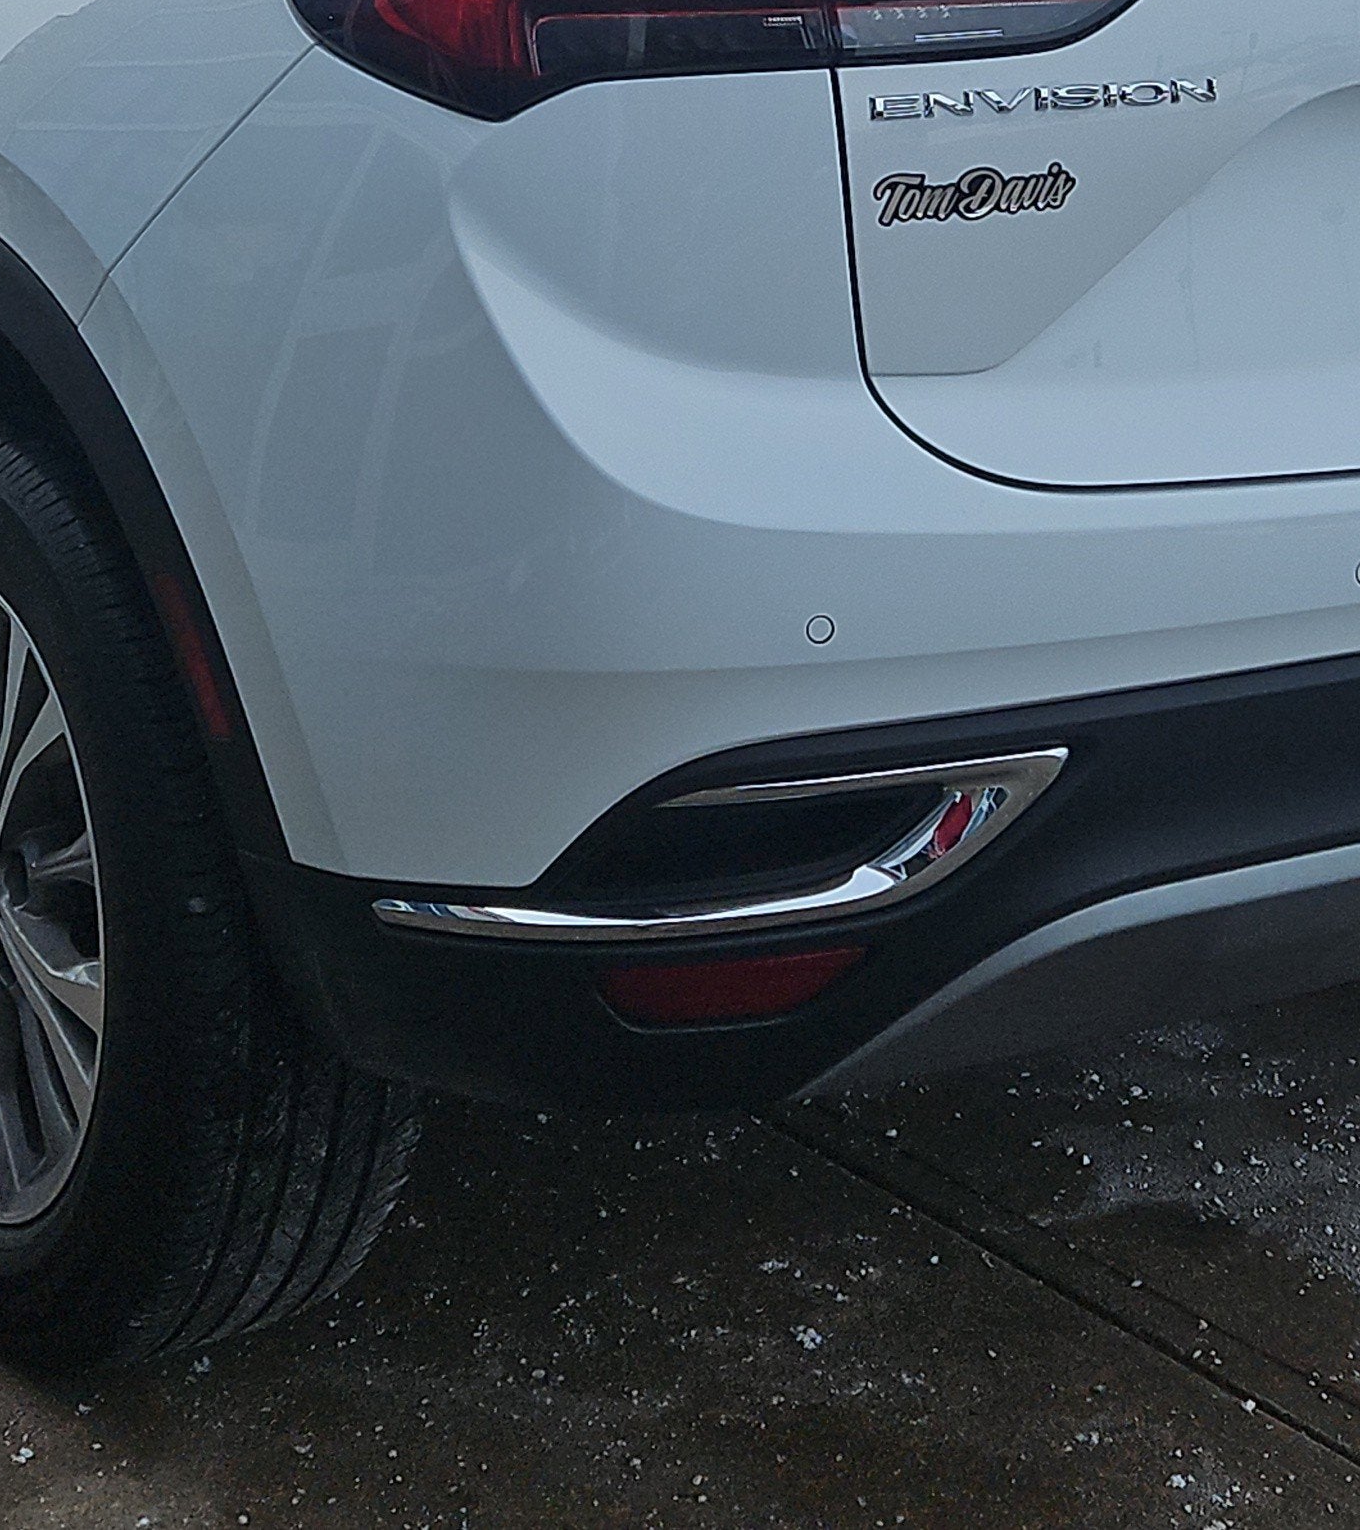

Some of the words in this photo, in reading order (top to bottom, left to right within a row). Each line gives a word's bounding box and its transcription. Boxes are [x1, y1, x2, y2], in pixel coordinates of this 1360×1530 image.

[868, 76, 1218, 121] ENVISION
[873, 172, 958, 227] Tom
[955, 160, 1077, 221] Davis
